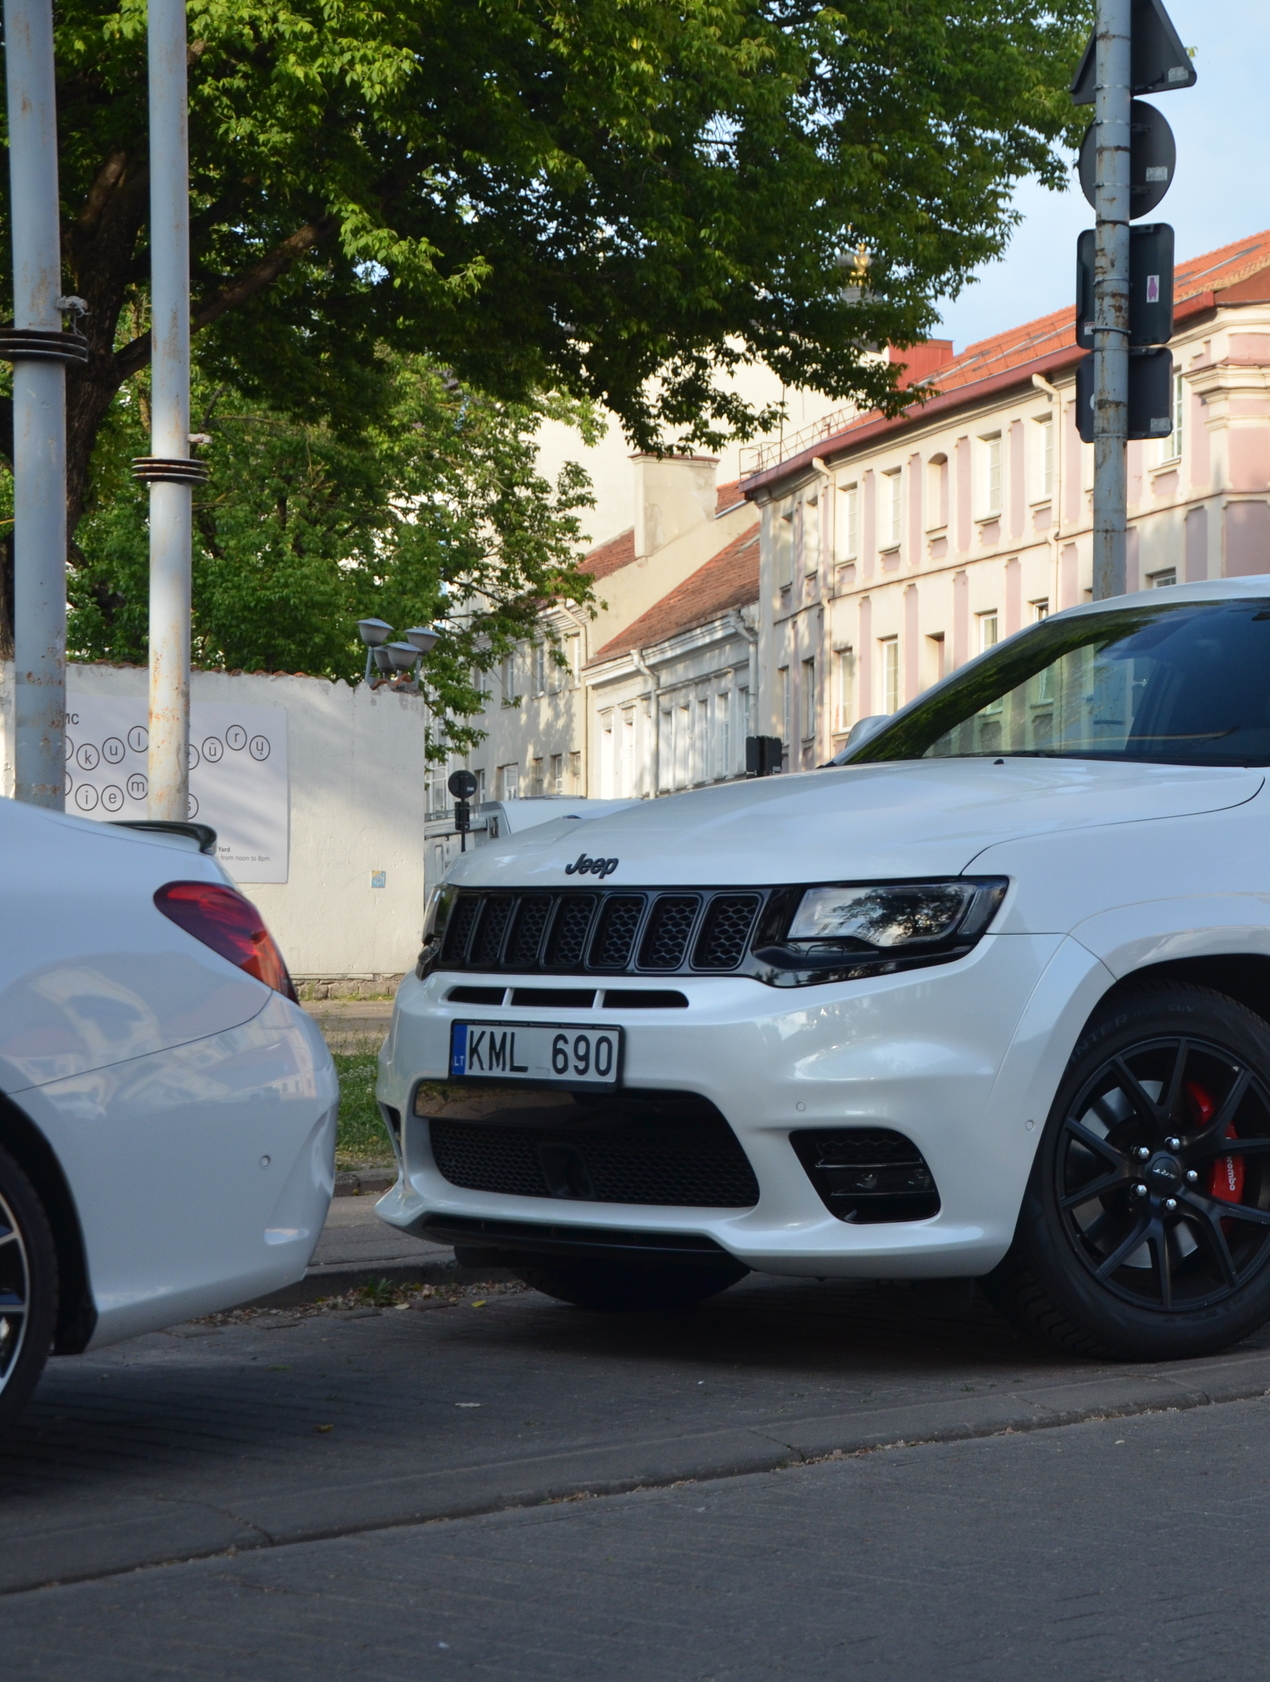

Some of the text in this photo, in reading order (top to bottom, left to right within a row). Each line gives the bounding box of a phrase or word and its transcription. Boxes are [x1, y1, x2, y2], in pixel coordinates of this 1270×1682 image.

[565, 853, 619, 879] Jeep
[453, 1055, 465, 1067] LT
[469, 1030, 613, 1077] KML 690
